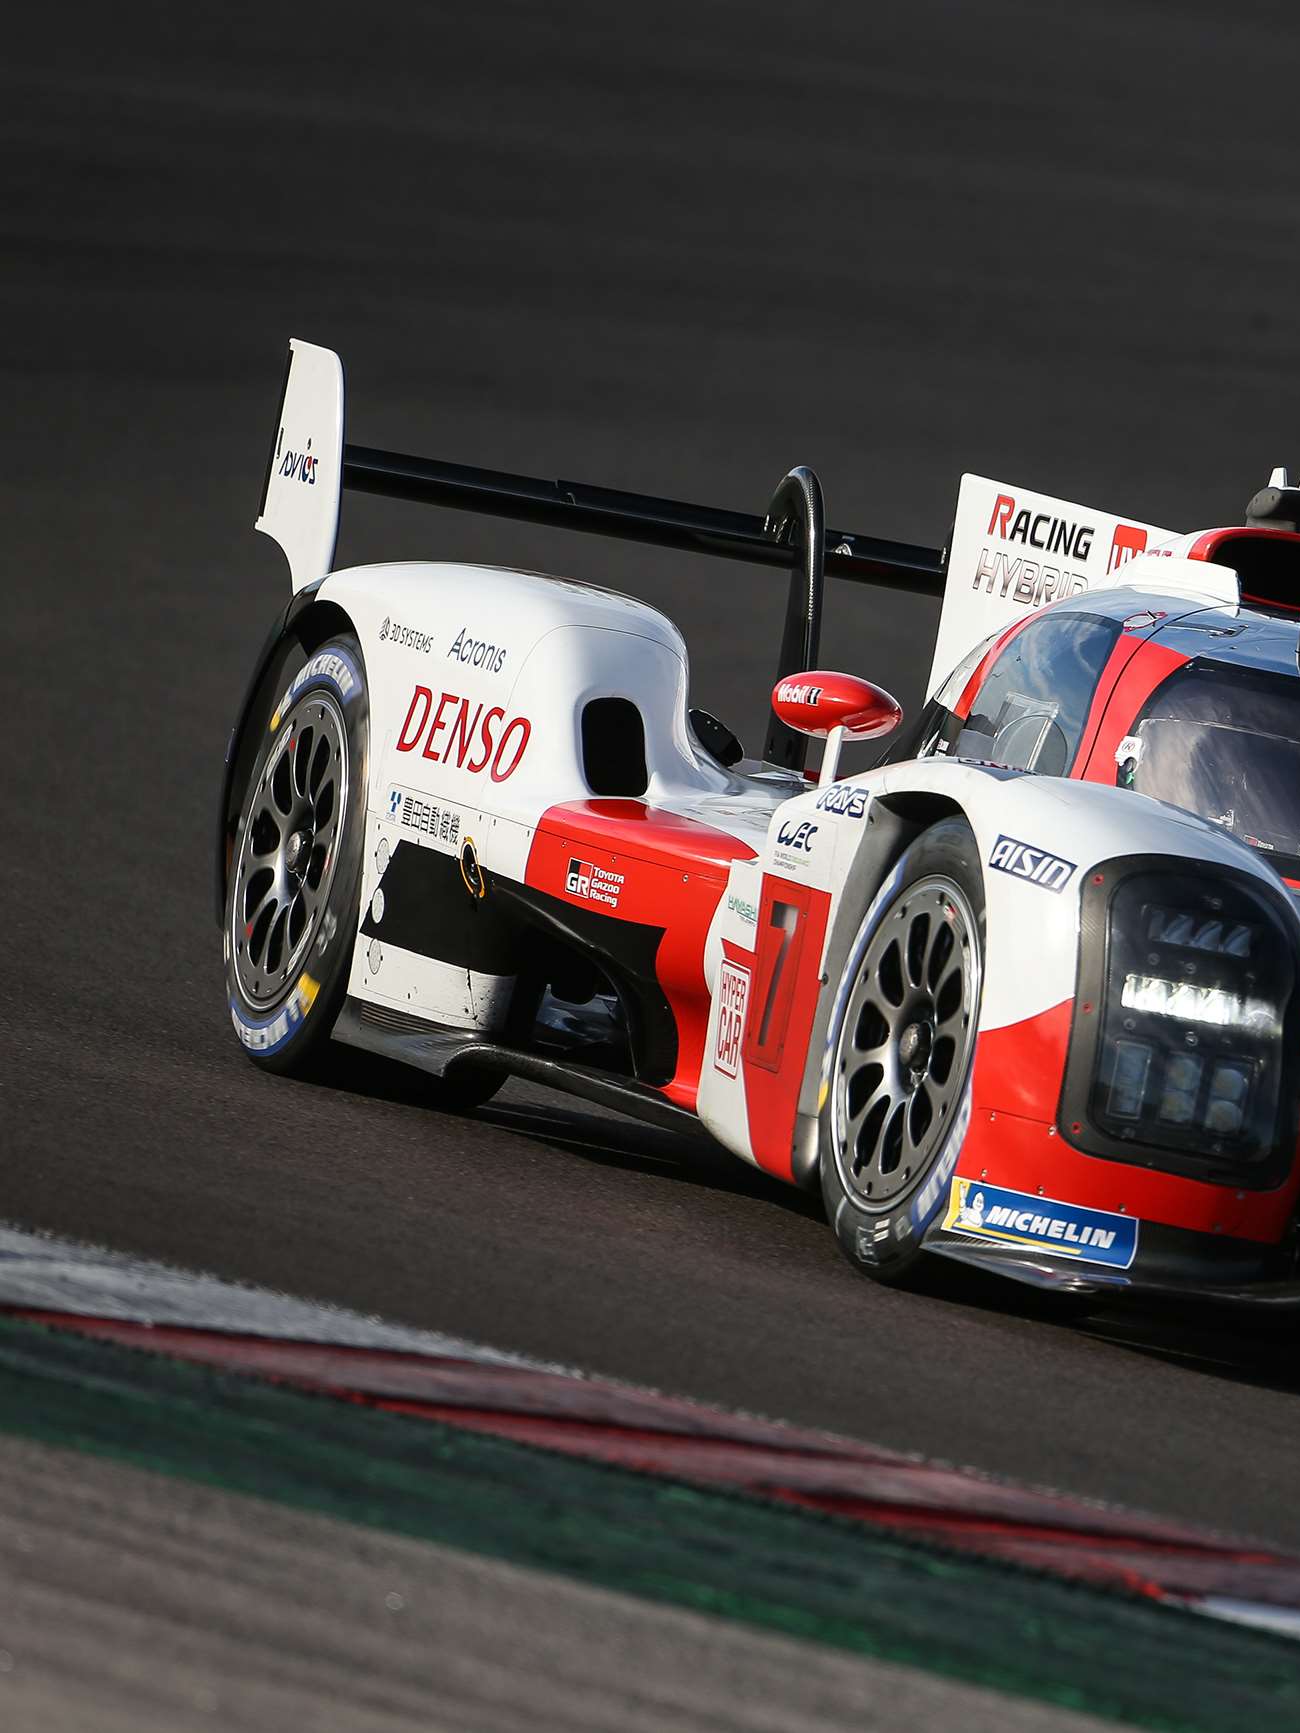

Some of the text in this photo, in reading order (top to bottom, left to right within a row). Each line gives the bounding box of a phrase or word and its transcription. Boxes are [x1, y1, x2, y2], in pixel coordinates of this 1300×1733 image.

[987, 493, 1096, 561] RACING
[399, 627, 434, 653] SYSTEMS
[447, 627, 506, 673] Acronis
[778, 683, 808, 704] Mobil
[396, 685, 532, 783] DENSO
[816, 784, 870, 818] RAYS
[777, 820, 818, 852] WEC
[567, 872, 589, 895] GR
[593, 866, 625, 884] TOYOTA
[991, 837, 1075, 891] AISIN
[589, 889, 618, 908] Racing
[591, 878, 620, 894] GAZOO
[721, 970, 746, 1014] HYPER
[758, 900, 800, 1047] 7
[717, 1006, 742, 1068] CAR
[984, 1204, 1117, 1250] MICHELIN
